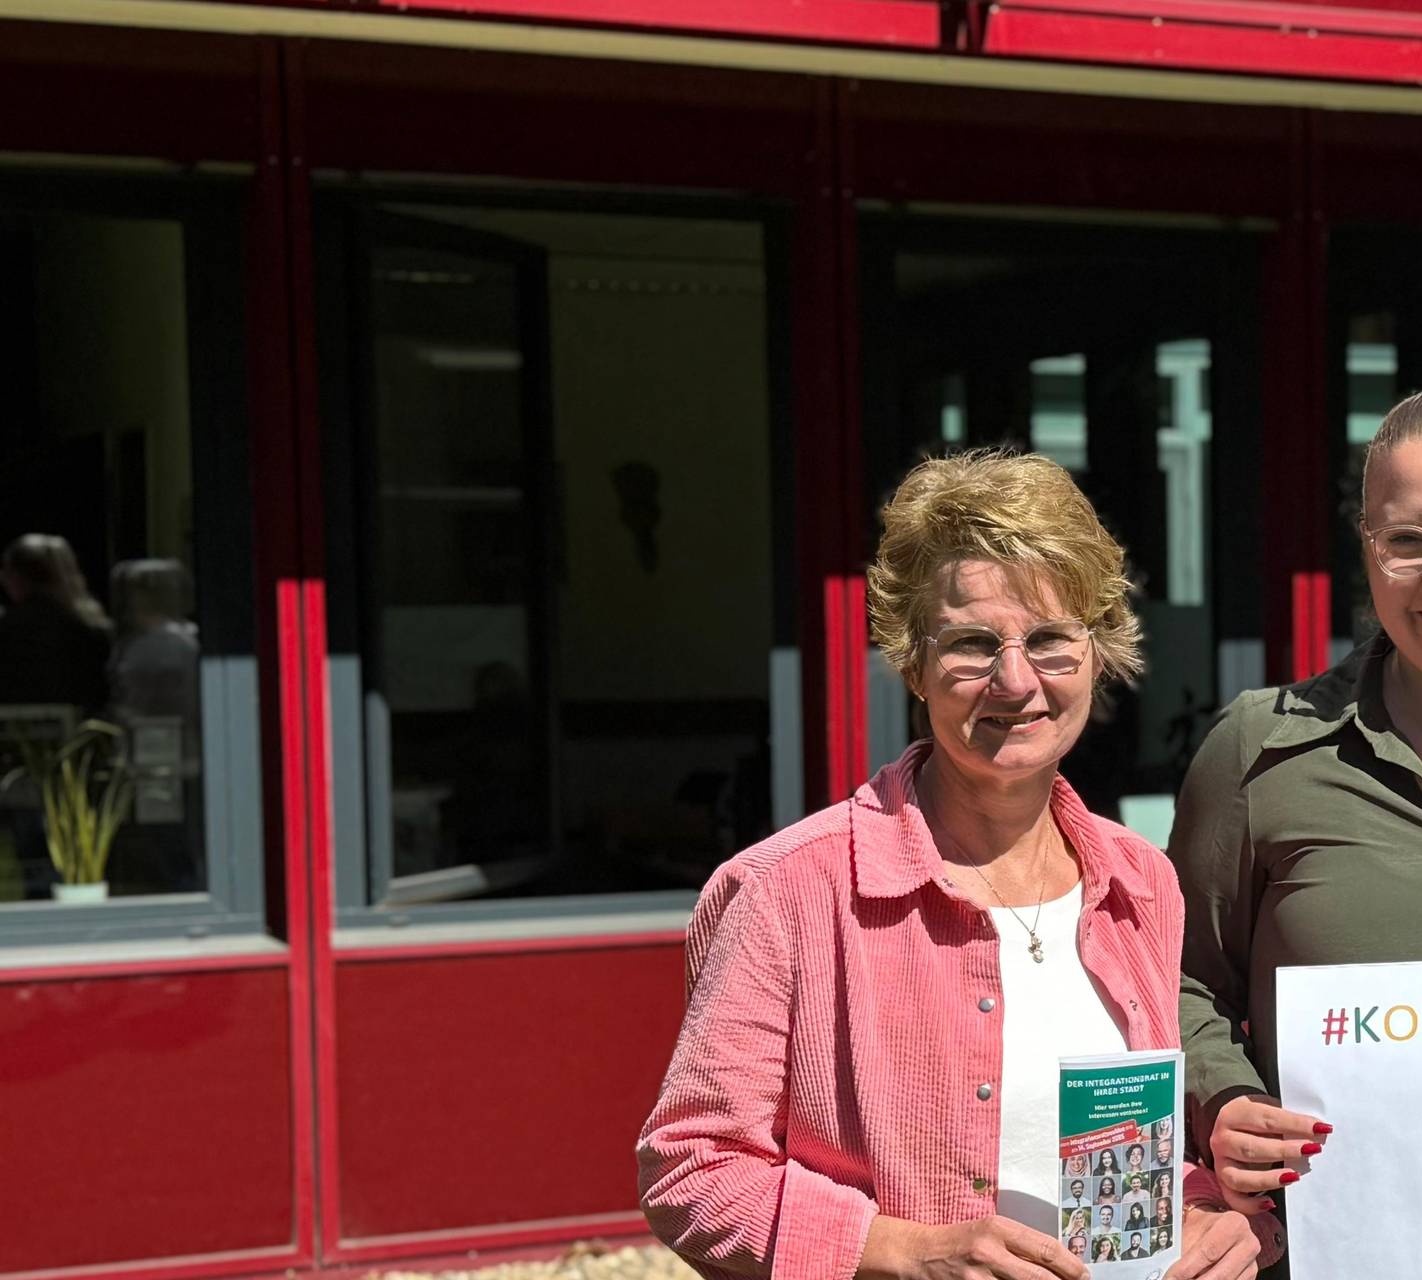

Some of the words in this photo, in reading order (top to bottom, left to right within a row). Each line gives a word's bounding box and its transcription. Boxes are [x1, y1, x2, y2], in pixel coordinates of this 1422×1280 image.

[1066, 1080, 1083, 1088] DER
[1085, 1073, 1158, 1088] INTEGRATIONSRAT
[1161, 1072, 1169, 1080] IN
[1093, 1087, 1118, 1097] IHRER
[1120, 1085, 1144, 1094] STADT
